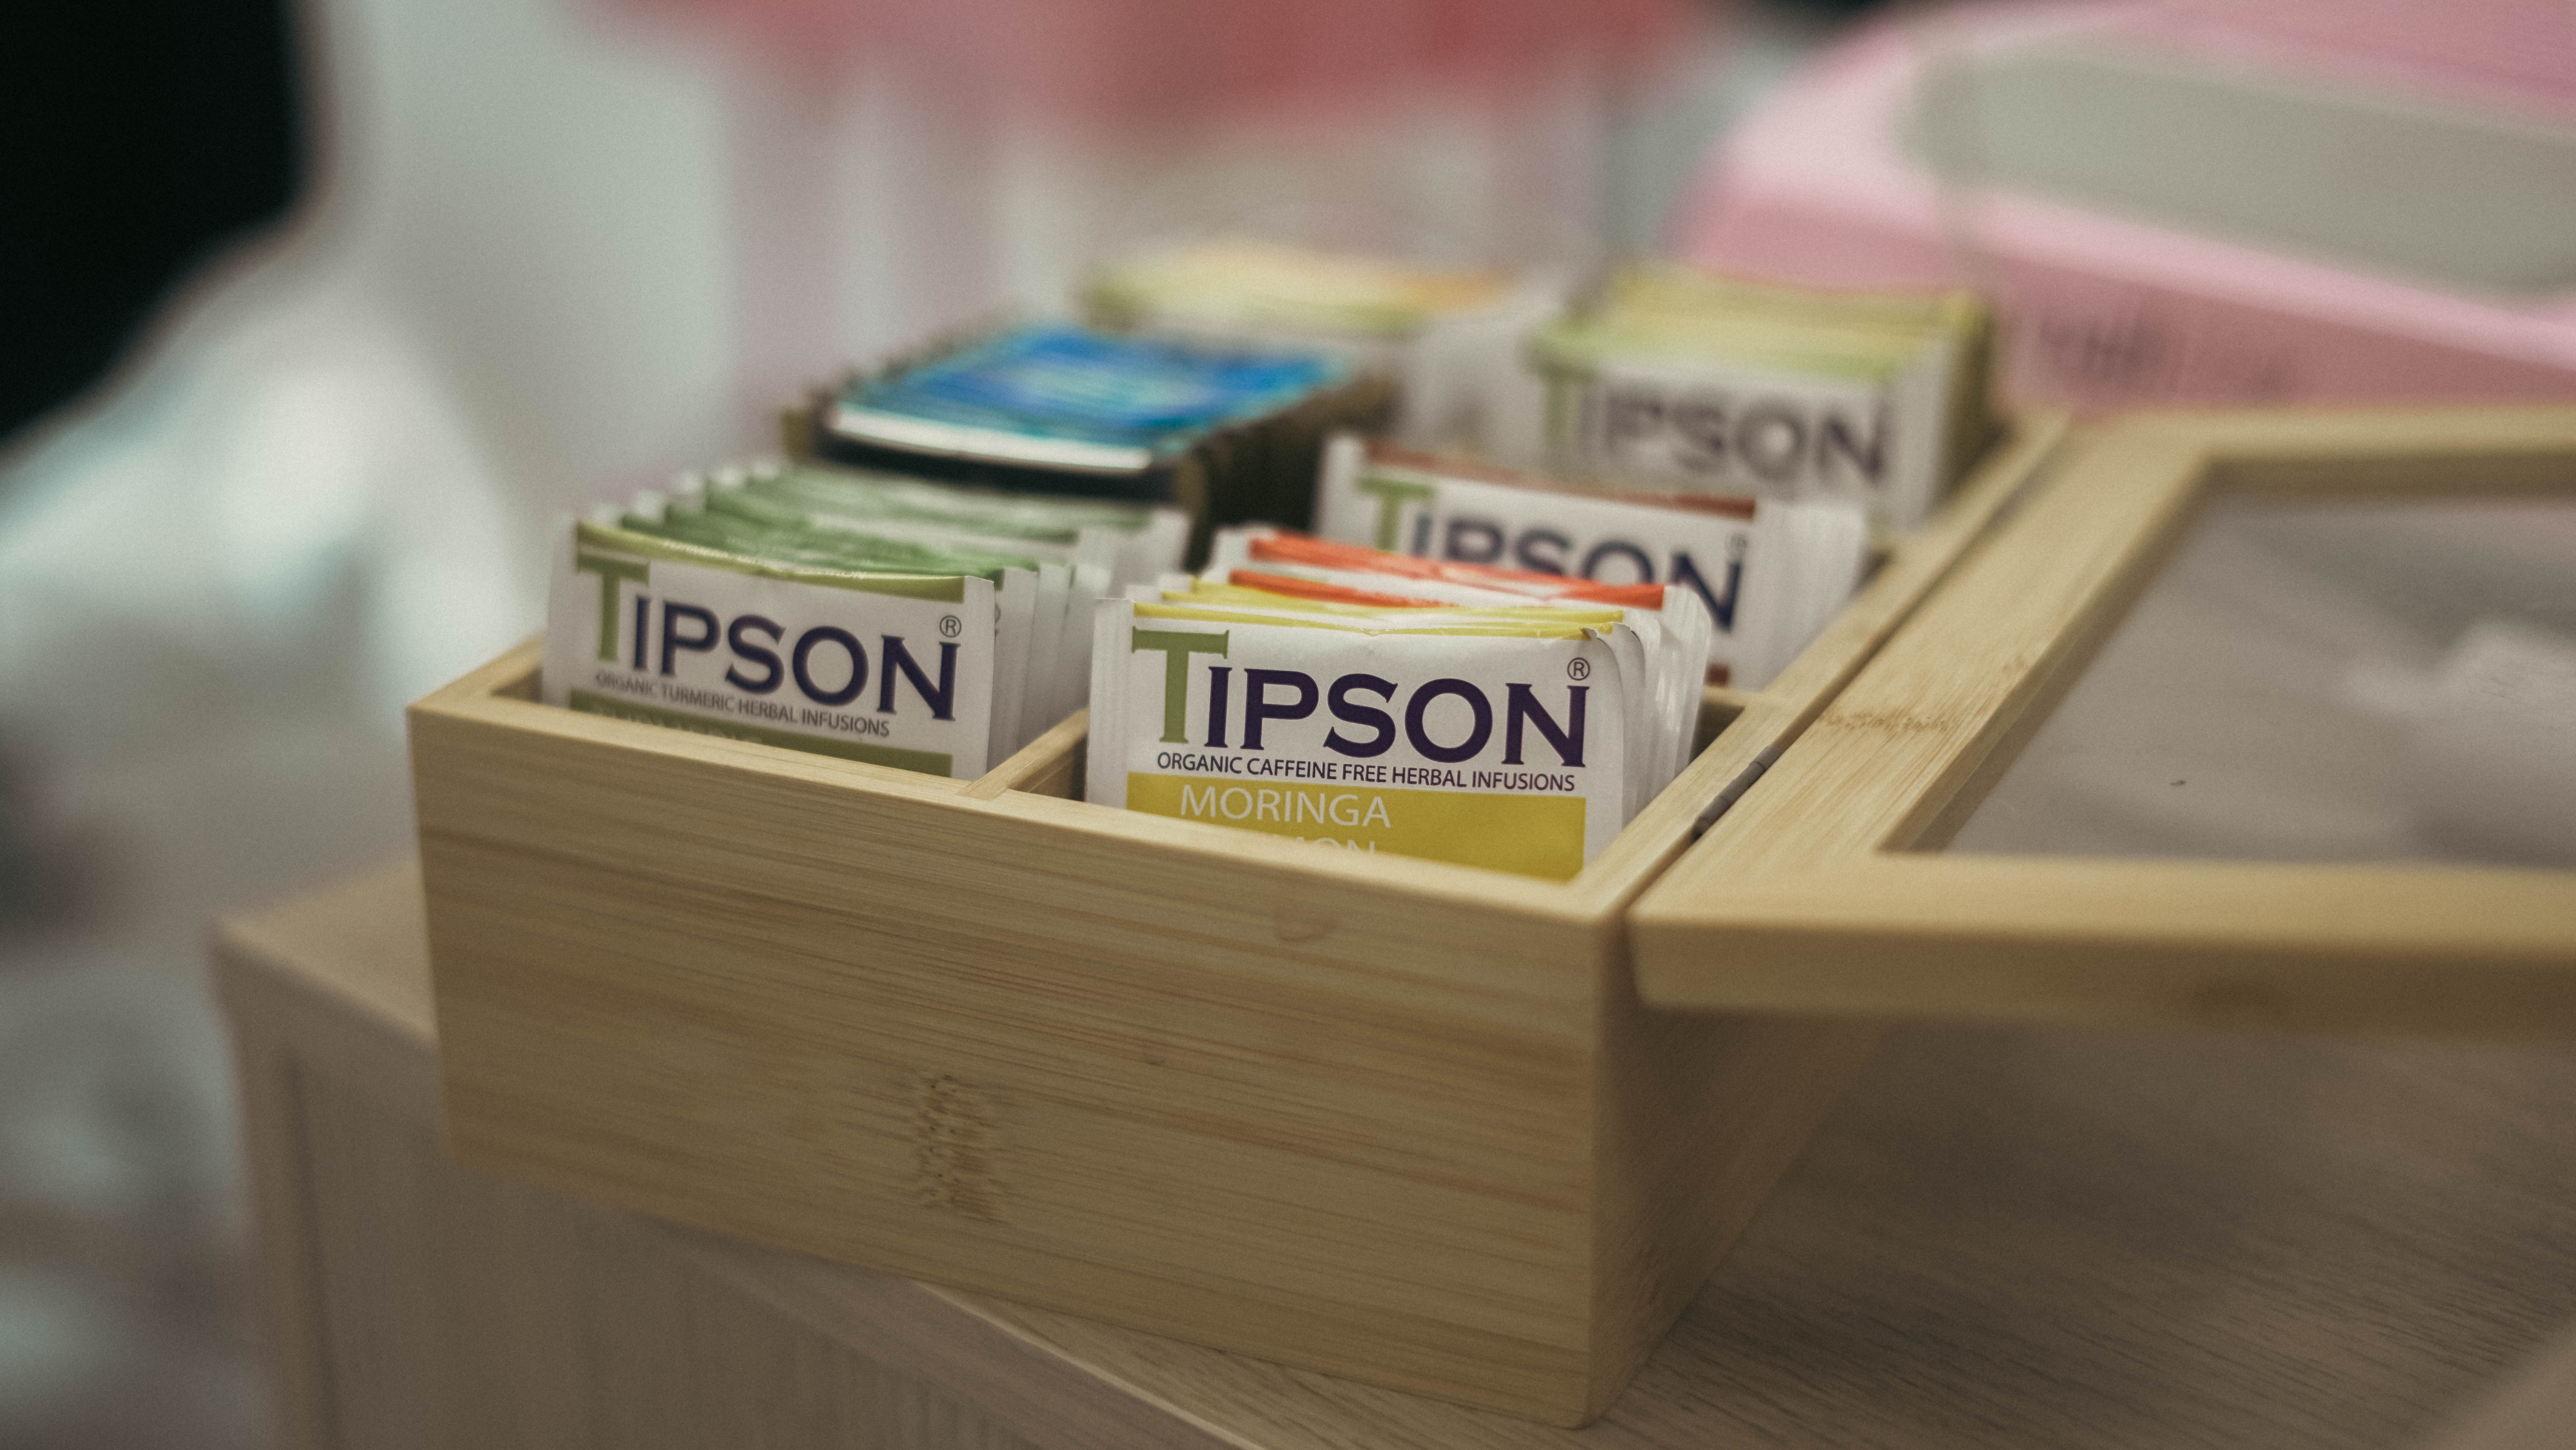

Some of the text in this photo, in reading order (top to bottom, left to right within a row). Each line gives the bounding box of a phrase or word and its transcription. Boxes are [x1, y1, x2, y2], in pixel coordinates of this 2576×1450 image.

[595, 671, 656, 696] ORGANIC
[660, 682, 736, 713] TURMERIC
[738, 698, 798, 724] HERBAL
[801, 707, 890, 737] INFUSIONS
[1130, 625, 1590, 768] TIPSON
[1157, 751, 1575, 792] ORGANIC CAFFEINE FREE HERBAL INFUSIONS
[1180, 784, 1392, 829] MORINGA
